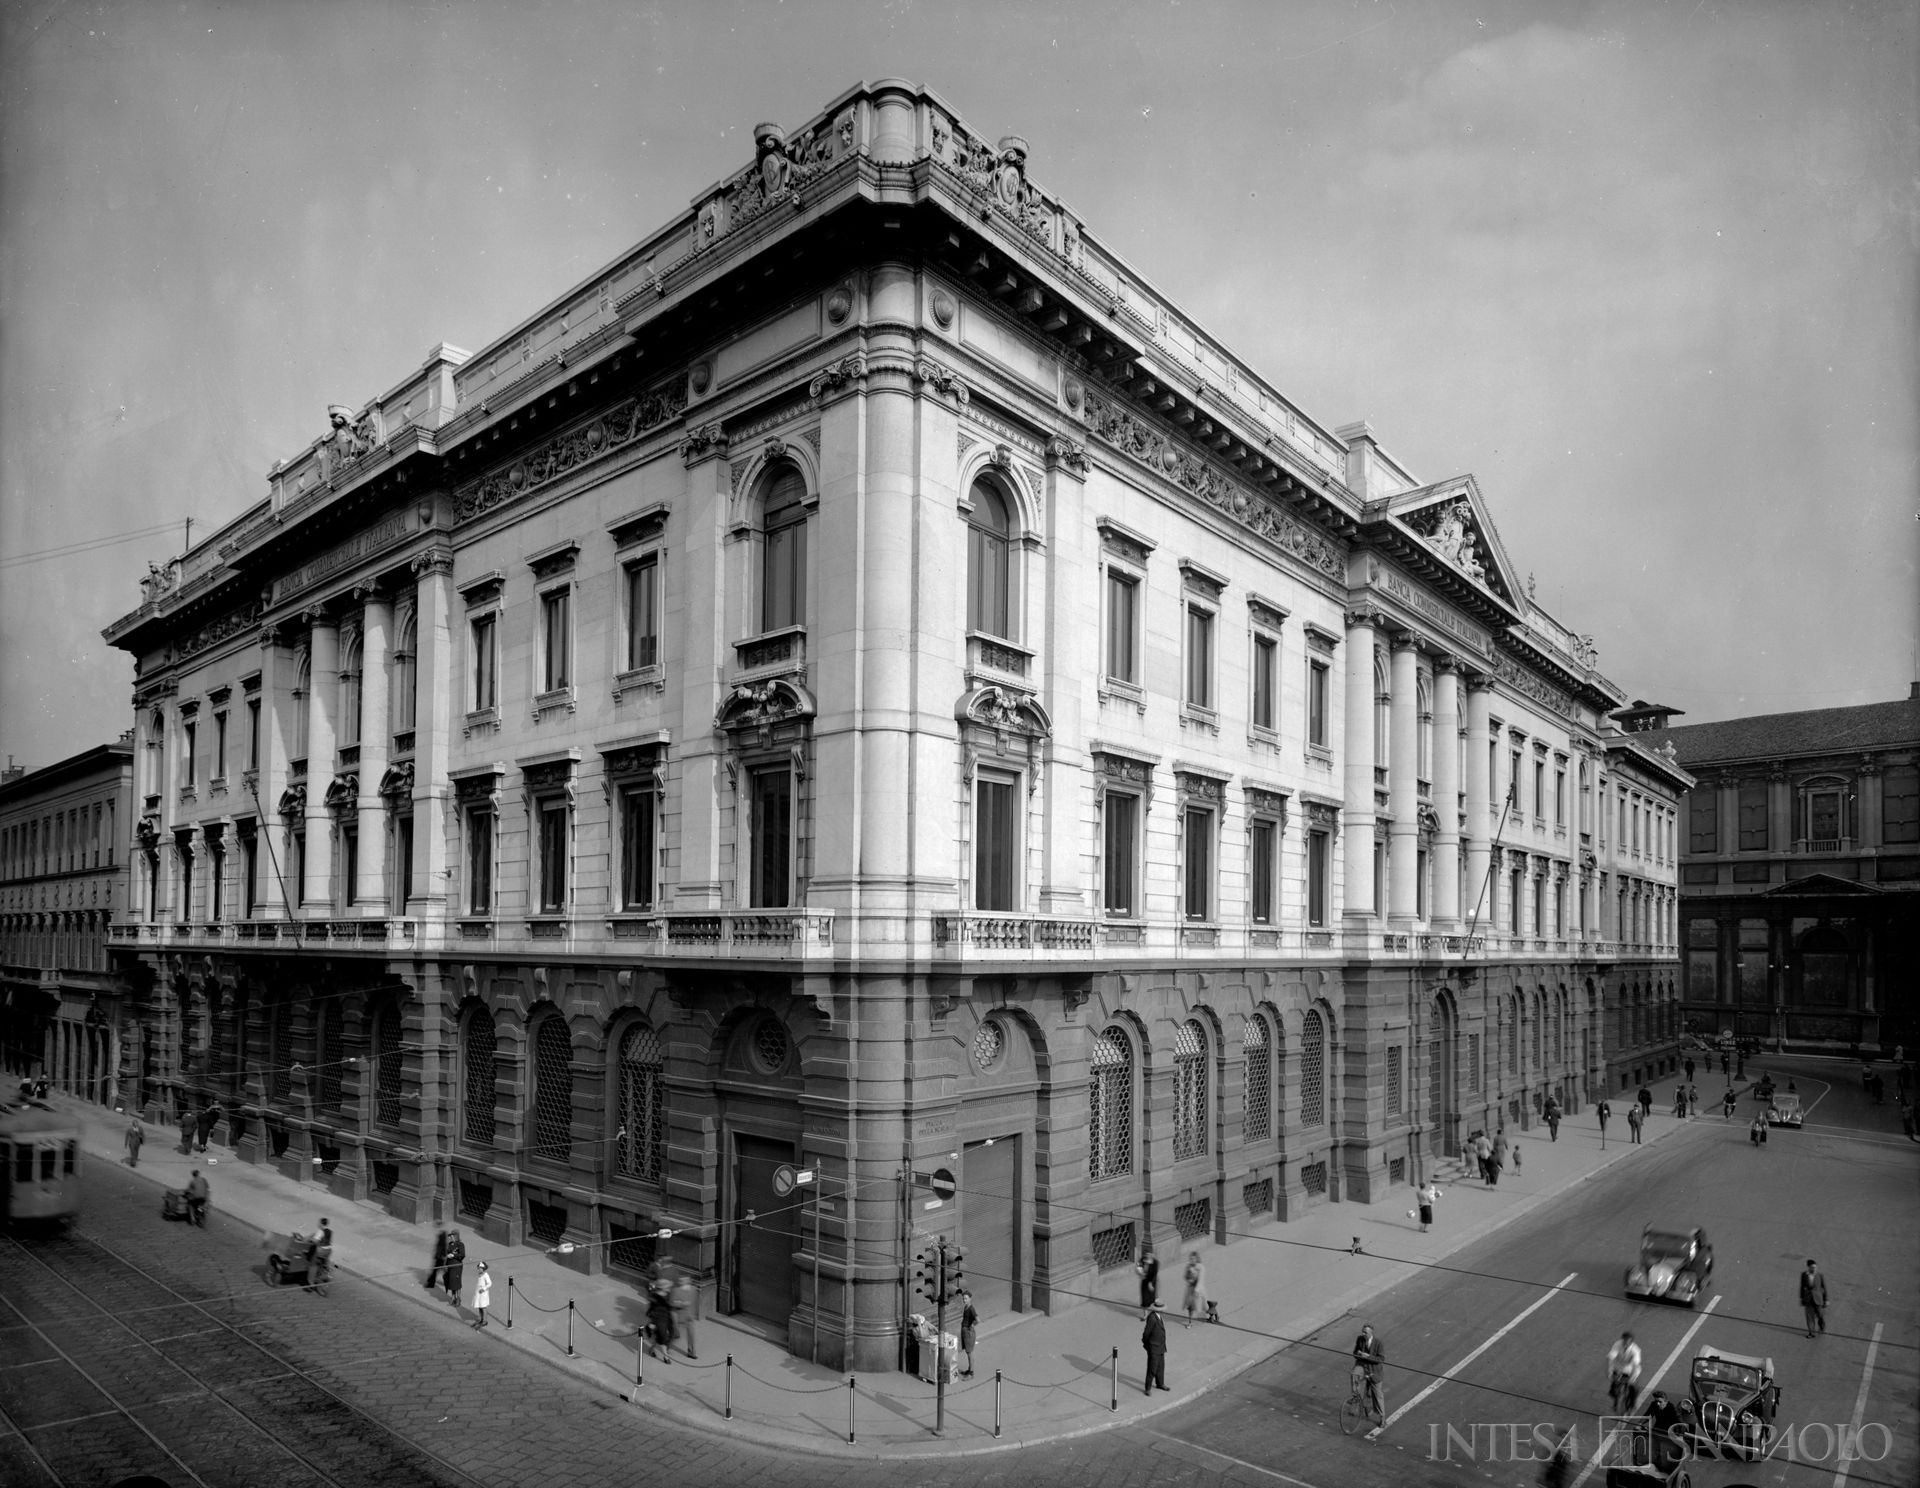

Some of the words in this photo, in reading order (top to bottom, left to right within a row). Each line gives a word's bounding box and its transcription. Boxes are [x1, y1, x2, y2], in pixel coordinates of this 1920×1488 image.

[279, 570, 304, 597] BANCA
[306, 538, 362, 582] COMMERCIALE
[365, 515, 408, 552] ITALIANA
[1387, 572, 1411, 603] BANCA
[1413, 591, 1456, 631] COMMERCIALE
[1456, 619, 1482, 648] ITALIANA
